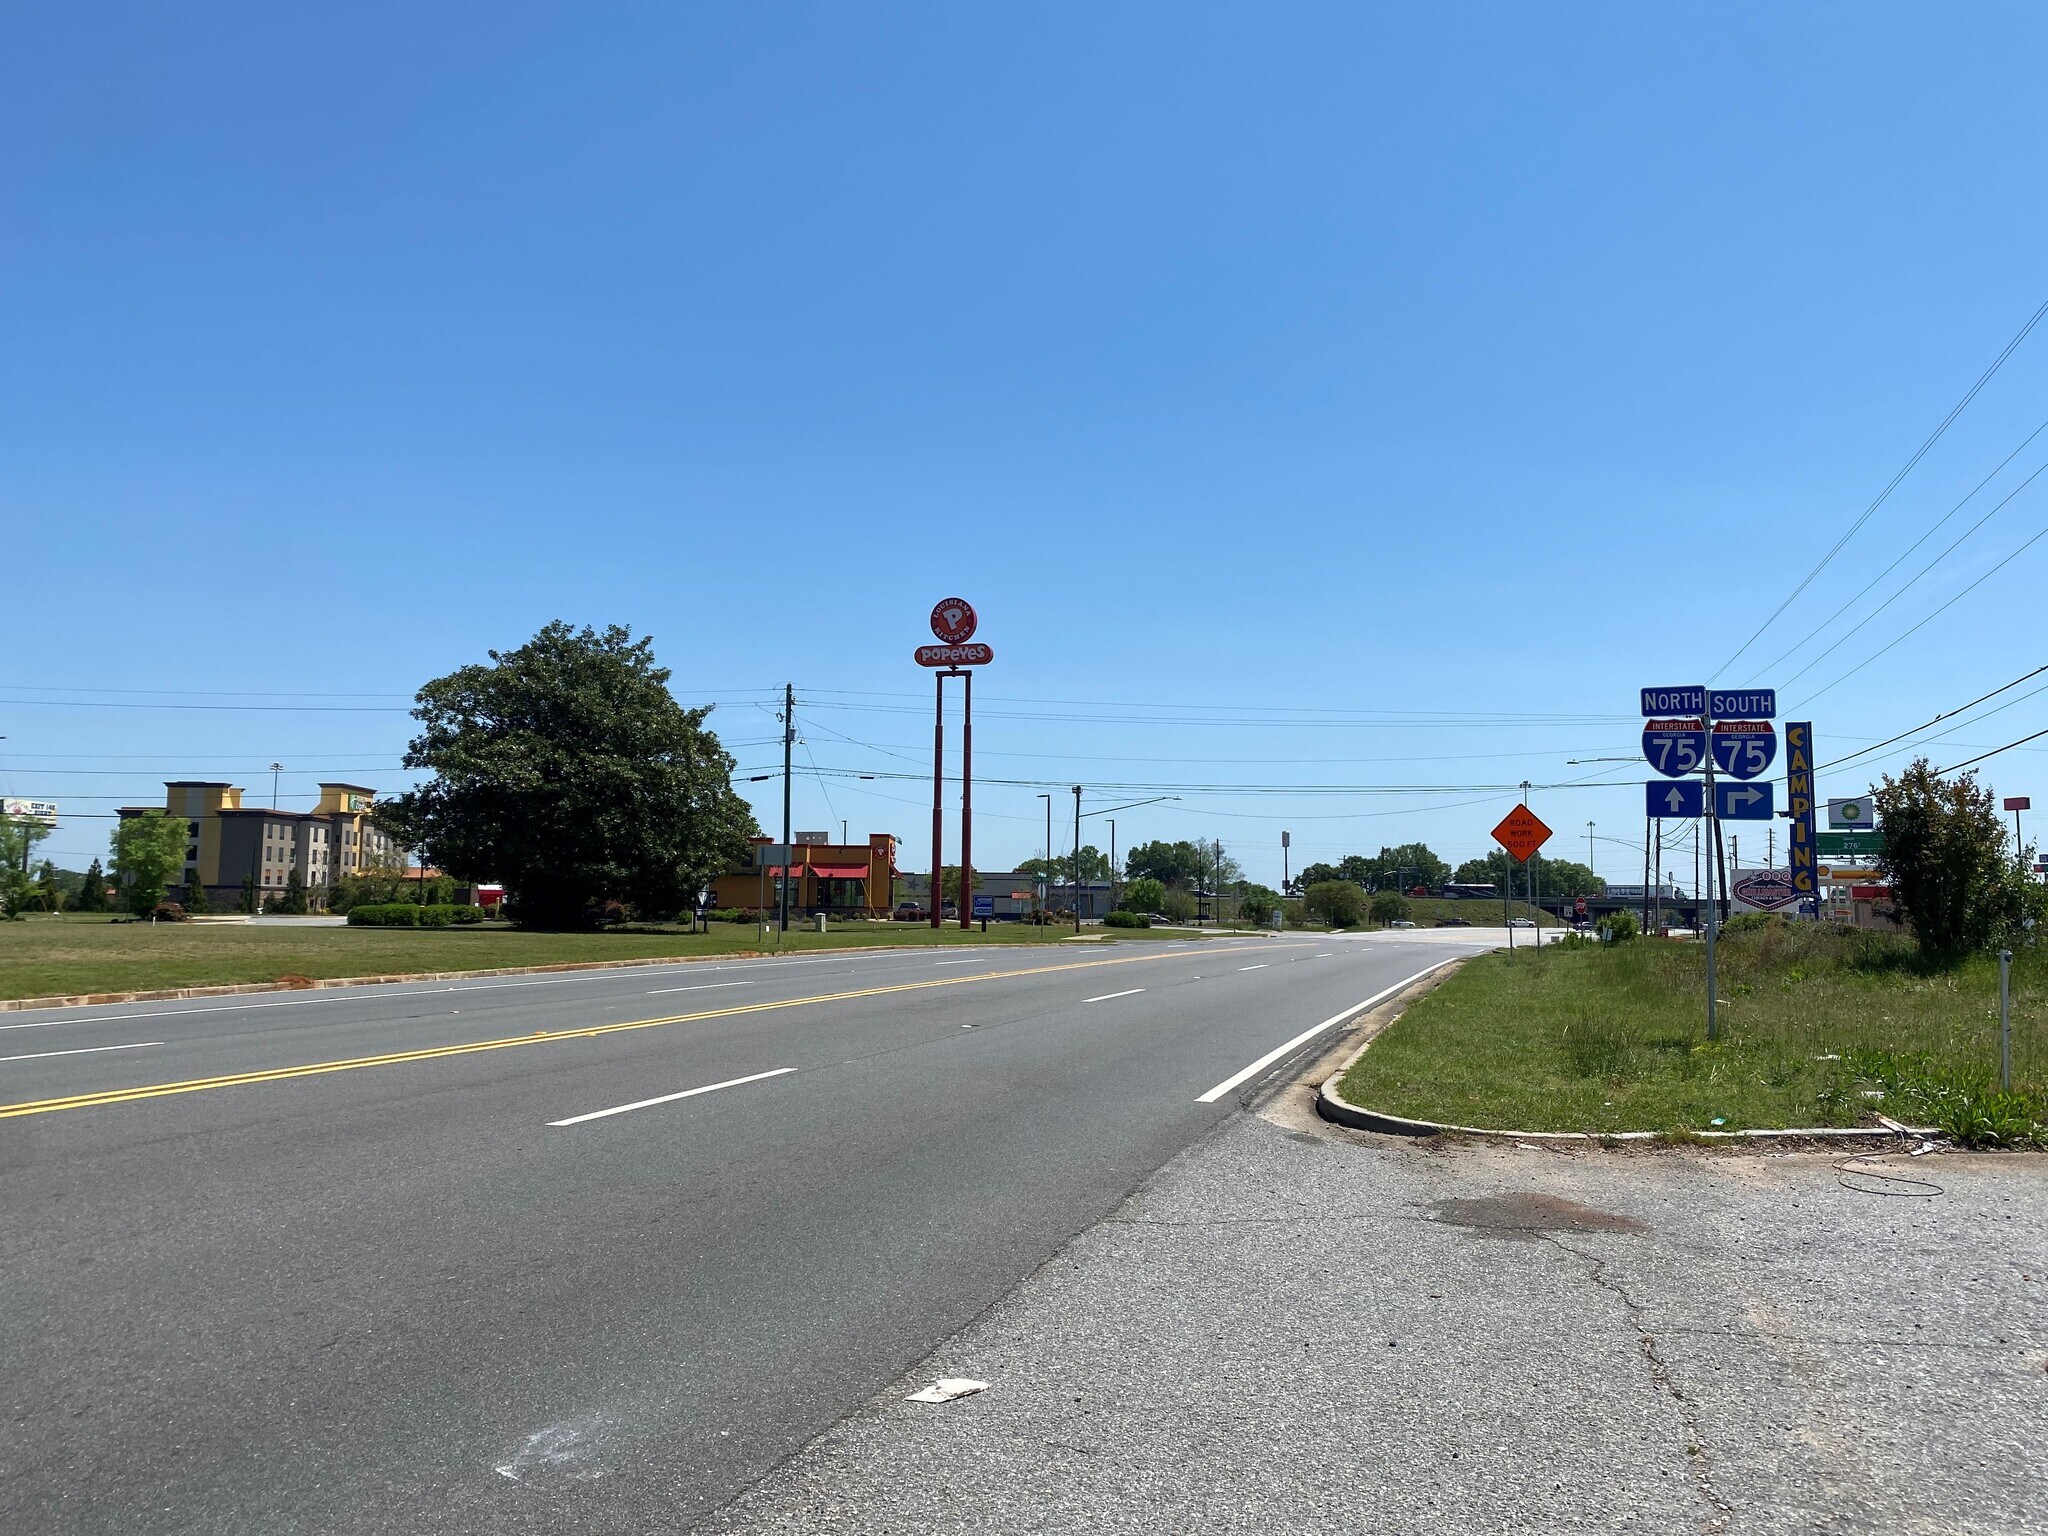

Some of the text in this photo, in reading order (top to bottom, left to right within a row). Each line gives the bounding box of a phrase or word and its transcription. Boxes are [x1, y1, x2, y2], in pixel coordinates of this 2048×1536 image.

[933, 599, 972, 618] LOUISIANA
[943, 608, 963, 631] P
[934, 625, 970, 641] KITCHEN
[1645, 692, 1702, 710] NORTH
[1713, 695, 1772, 713] SOUTH
[1652, 721, 1696, 731] INTERSTATE
[1720, 723, 1765, 732] INTERSTATE
[1653, 739, 1697, 770] 75
[1722, 741, 1766, 772] 75
[1788, 727, 1812, 891] CAMPING
[1510, 829, 1533, 837] WORK
